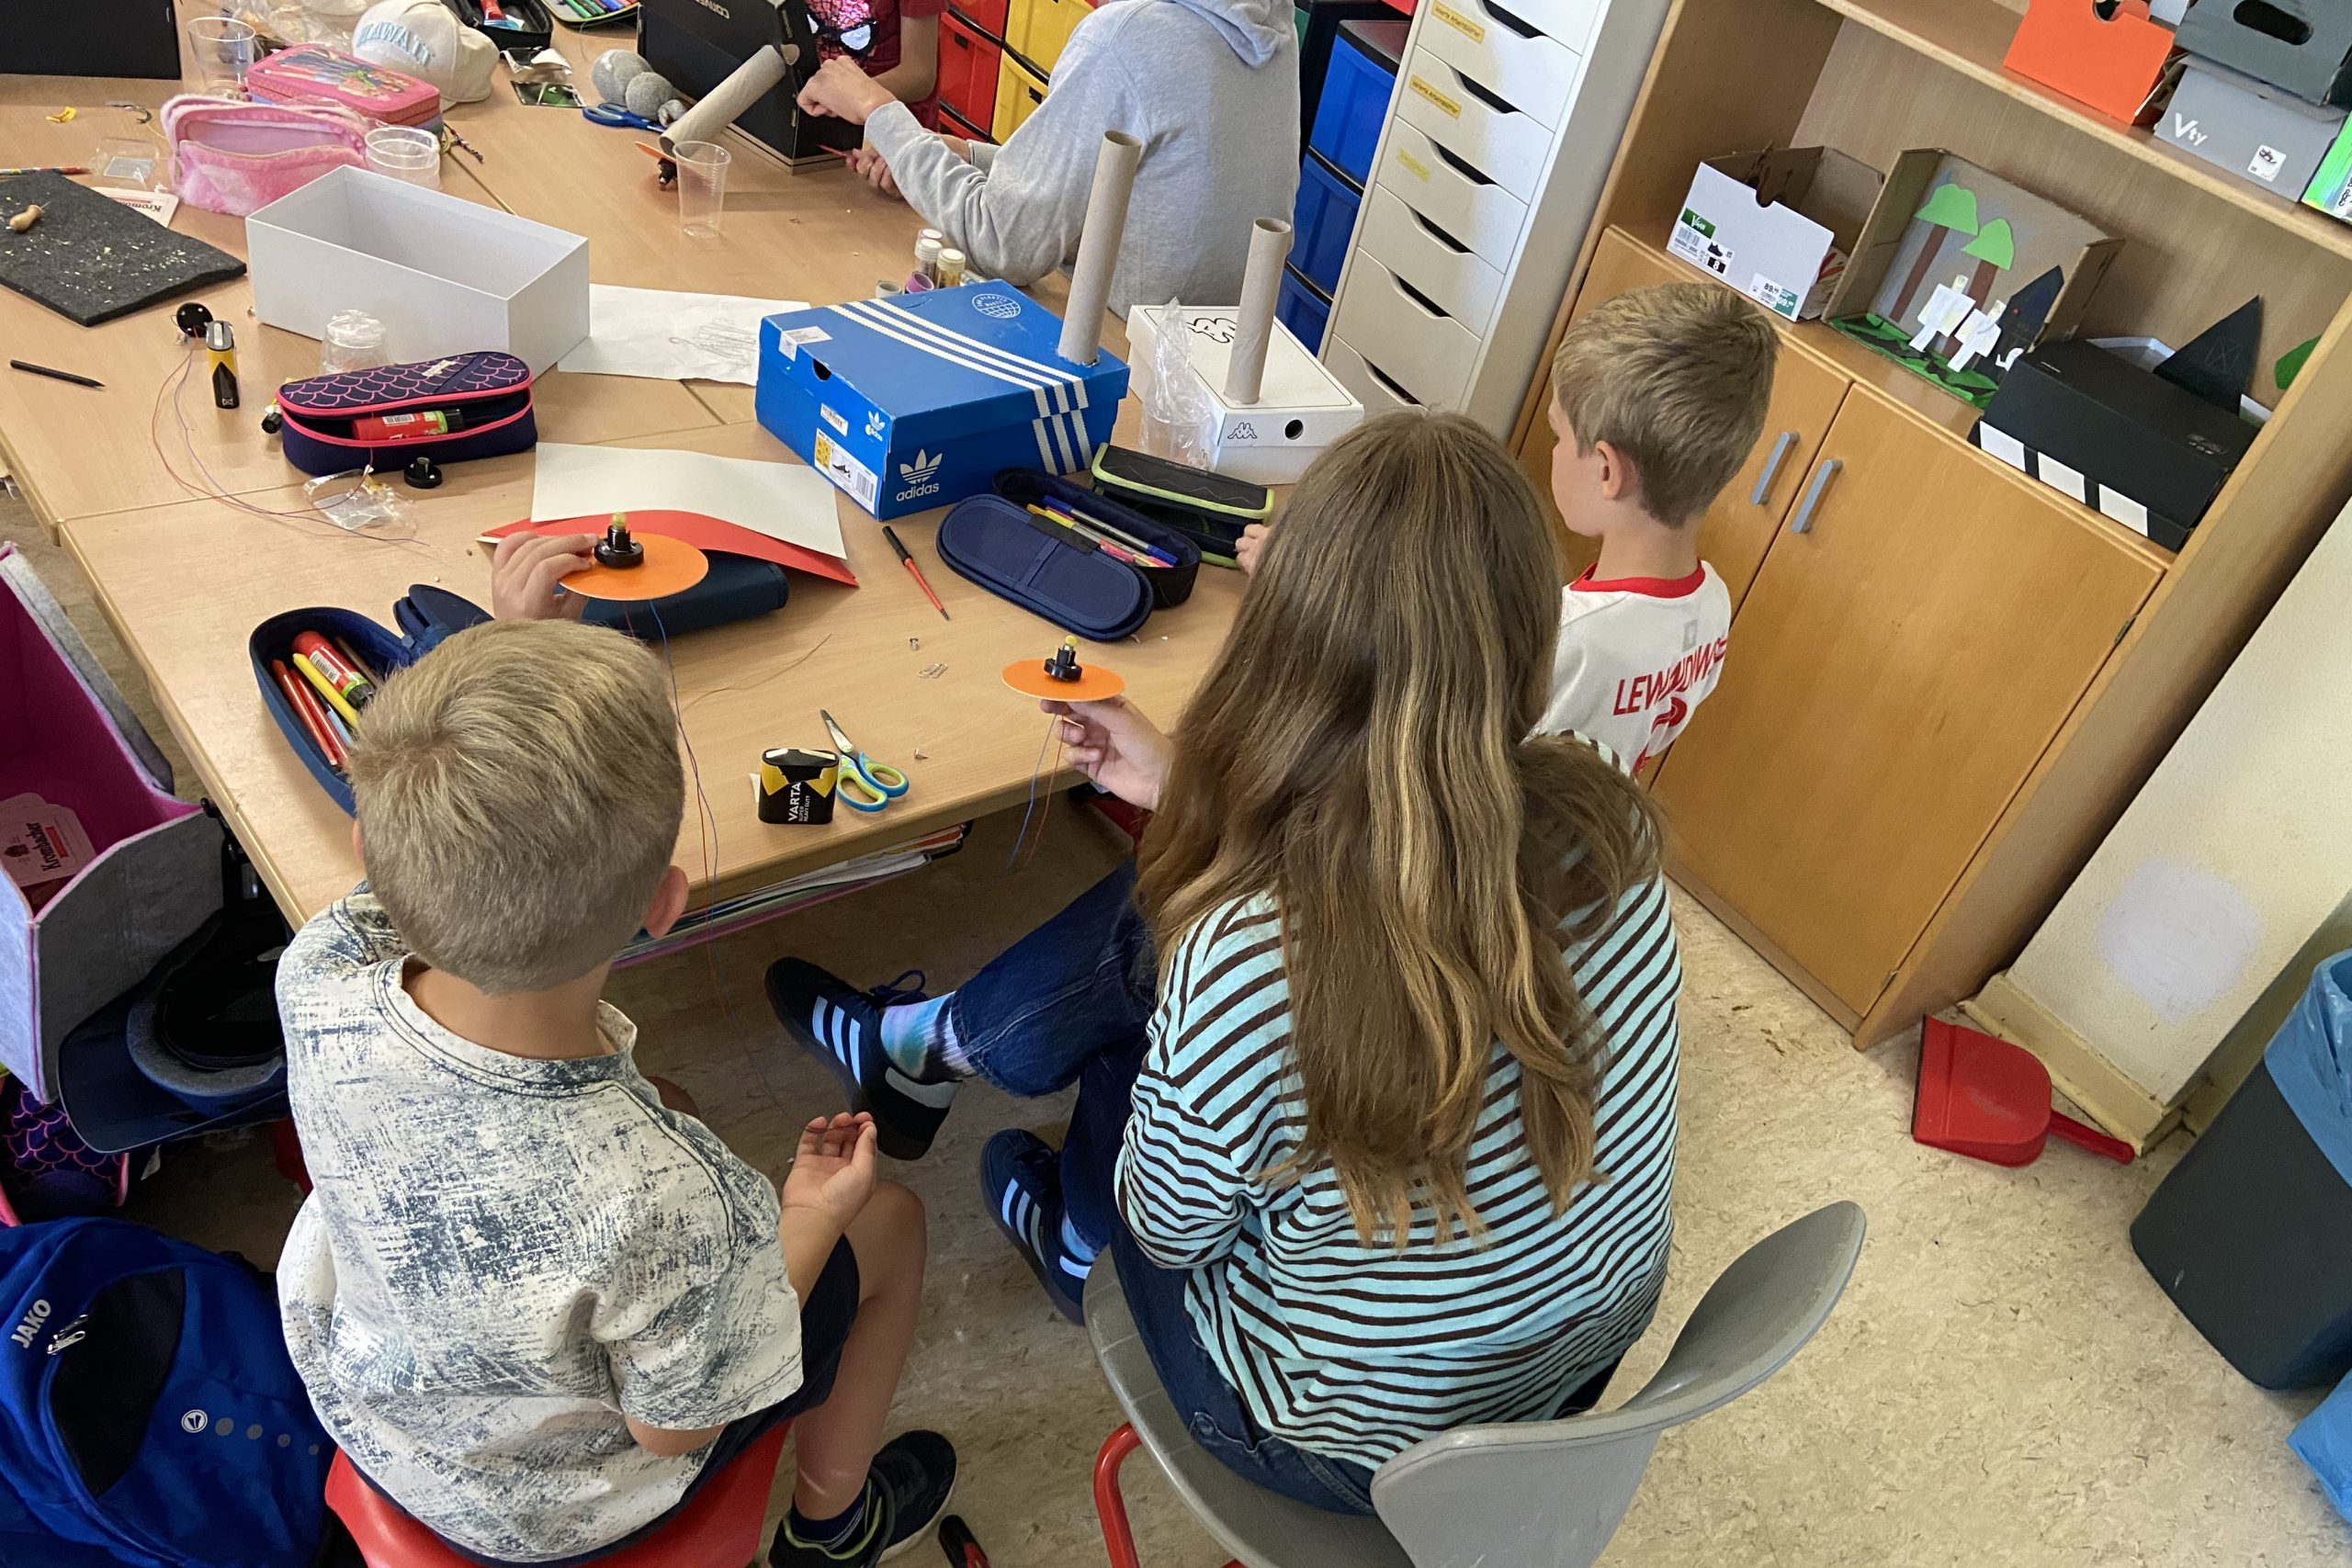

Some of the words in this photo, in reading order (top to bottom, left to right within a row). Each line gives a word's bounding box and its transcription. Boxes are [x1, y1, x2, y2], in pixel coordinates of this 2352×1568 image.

[695, 0, 730, 19] CONVE
[1713, 260, 1721, 270] 8
[896, 482, 940, 502] adidas
[787, 782, 801, 822] VARTA
[25, 822, 62, 872] Krombacher
[10, 1299, 51, 1349] JAKO
